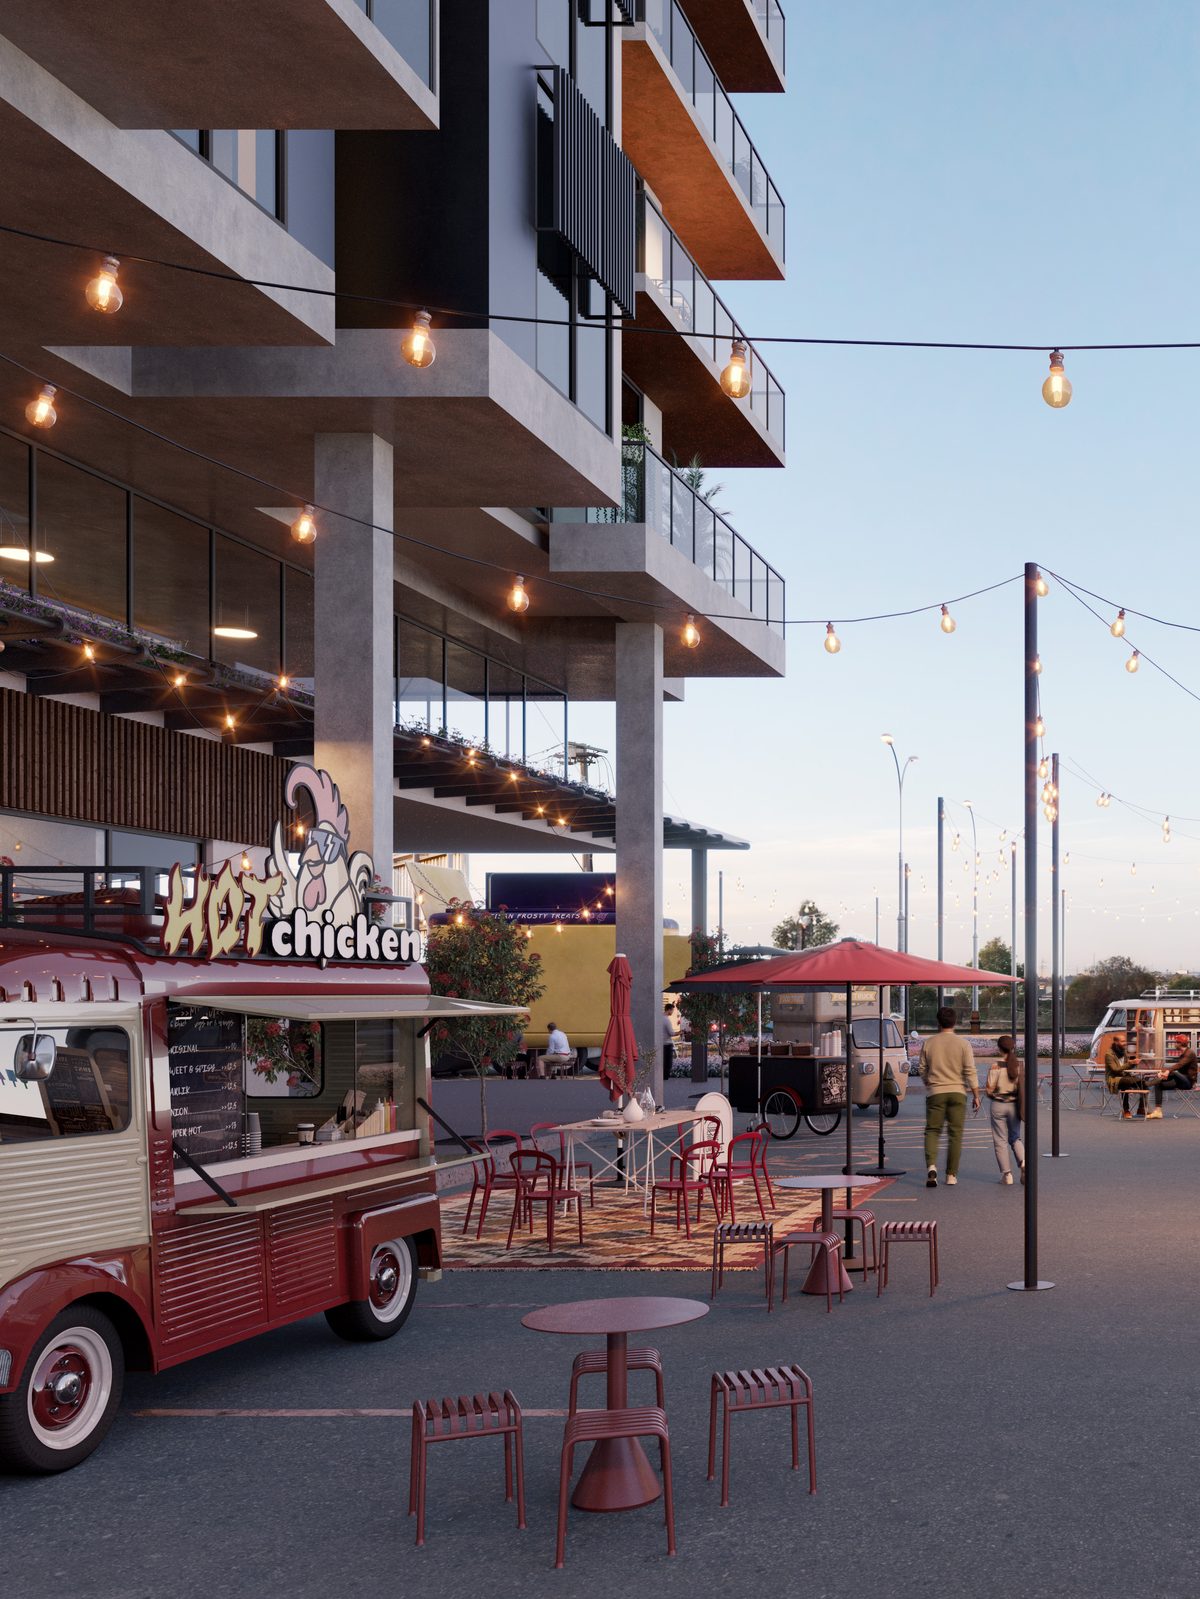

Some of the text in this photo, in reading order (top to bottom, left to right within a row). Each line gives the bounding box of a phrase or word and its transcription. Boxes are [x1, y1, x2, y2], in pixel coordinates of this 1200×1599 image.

[162, 858, 285, 961] HOT
[517, 912, 547, 920] FROSTY
[551, 912, 580, 920] TREATS
[270, 907, 421, 962] chicken
[169, 1065, 188, 1077] WEET
[170, 1086, 190, 1097] ARLIK
[170, 1106, 189, 1118] NION
